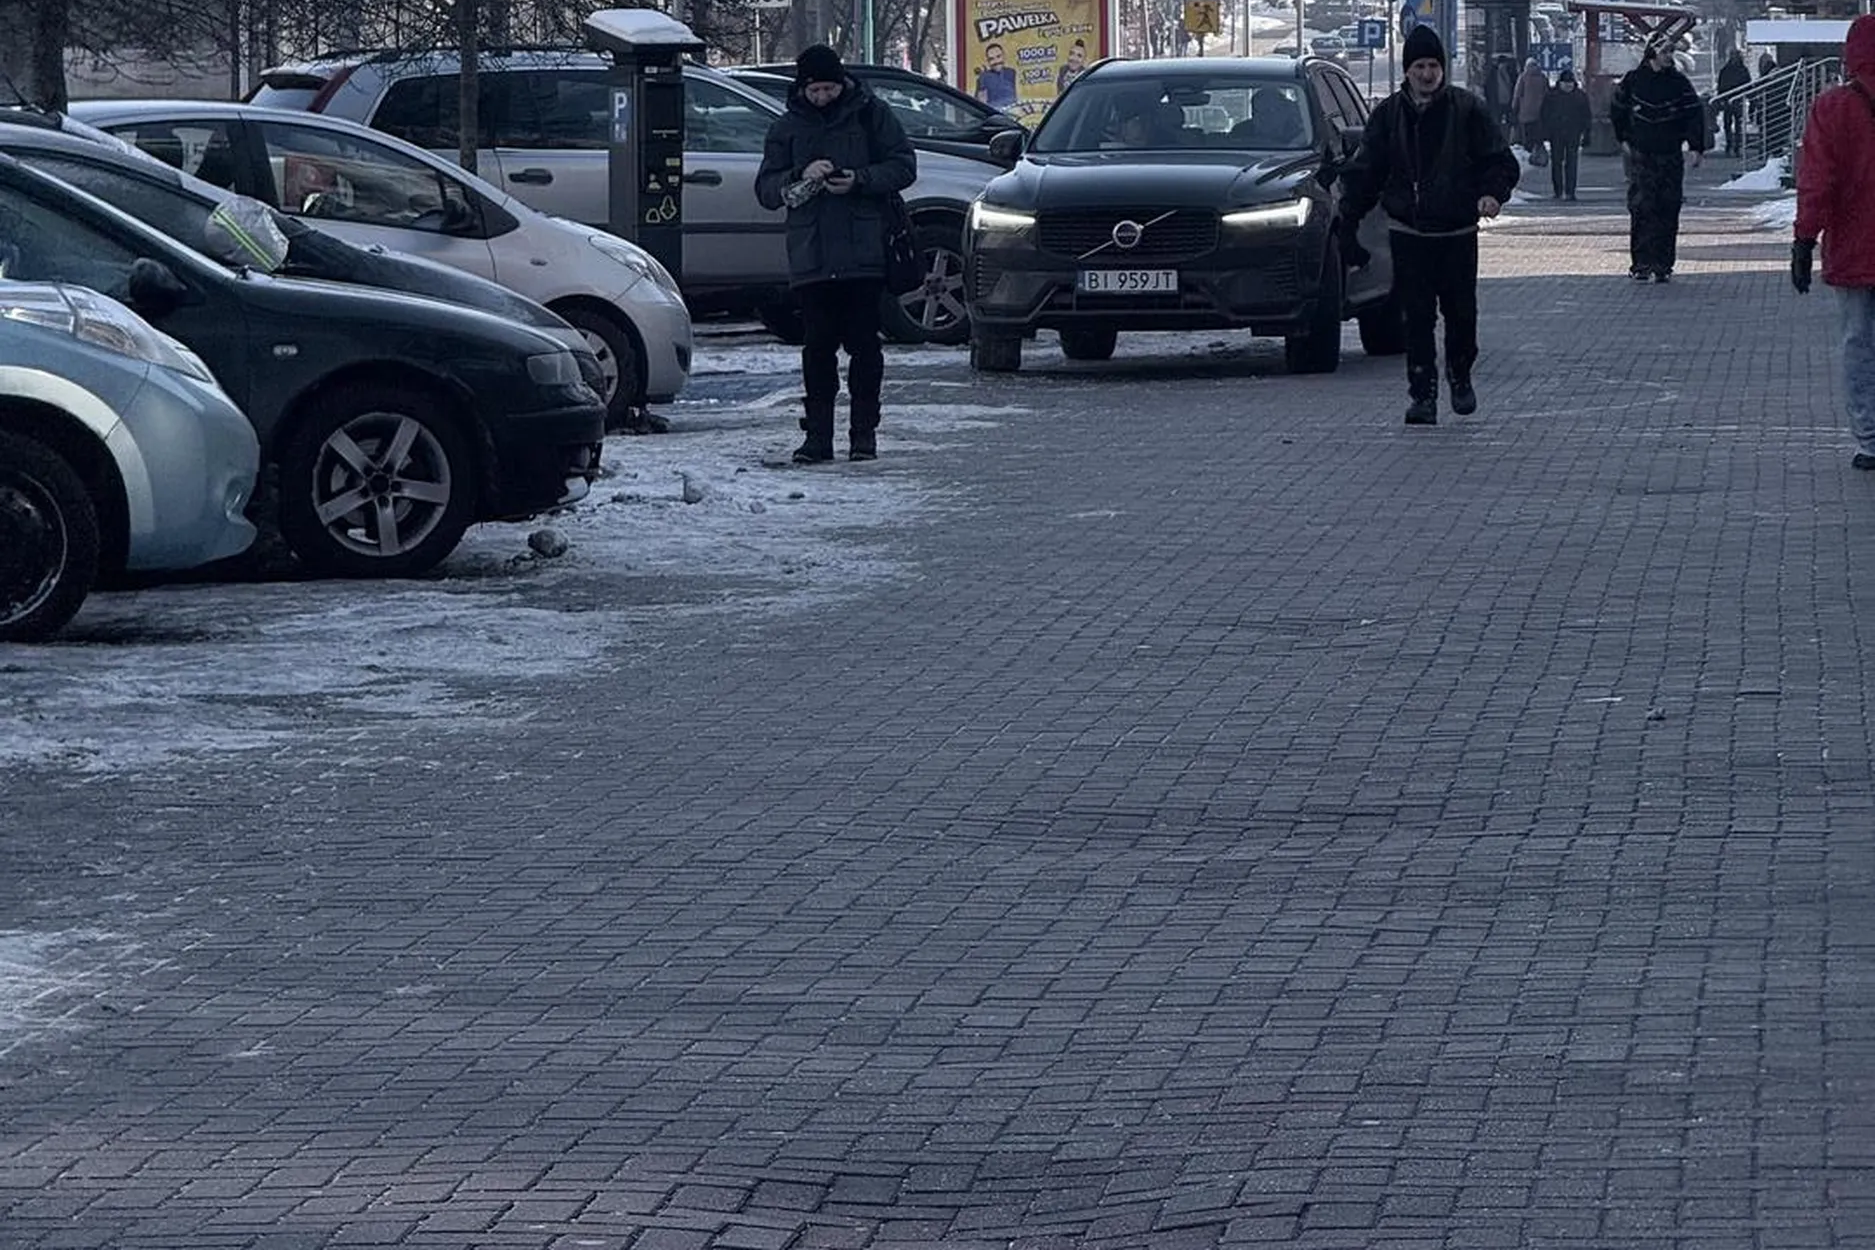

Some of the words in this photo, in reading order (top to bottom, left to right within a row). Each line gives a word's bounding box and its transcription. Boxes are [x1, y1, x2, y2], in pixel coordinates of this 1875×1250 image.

[1364, 25, 1382, 45] P
[1019, 47, 1045, 59] 1000
[614, 92, 627, 119] P
[1088, 272, 1109, 289] BI
[1118, 272, 1173, 290] 959JT
